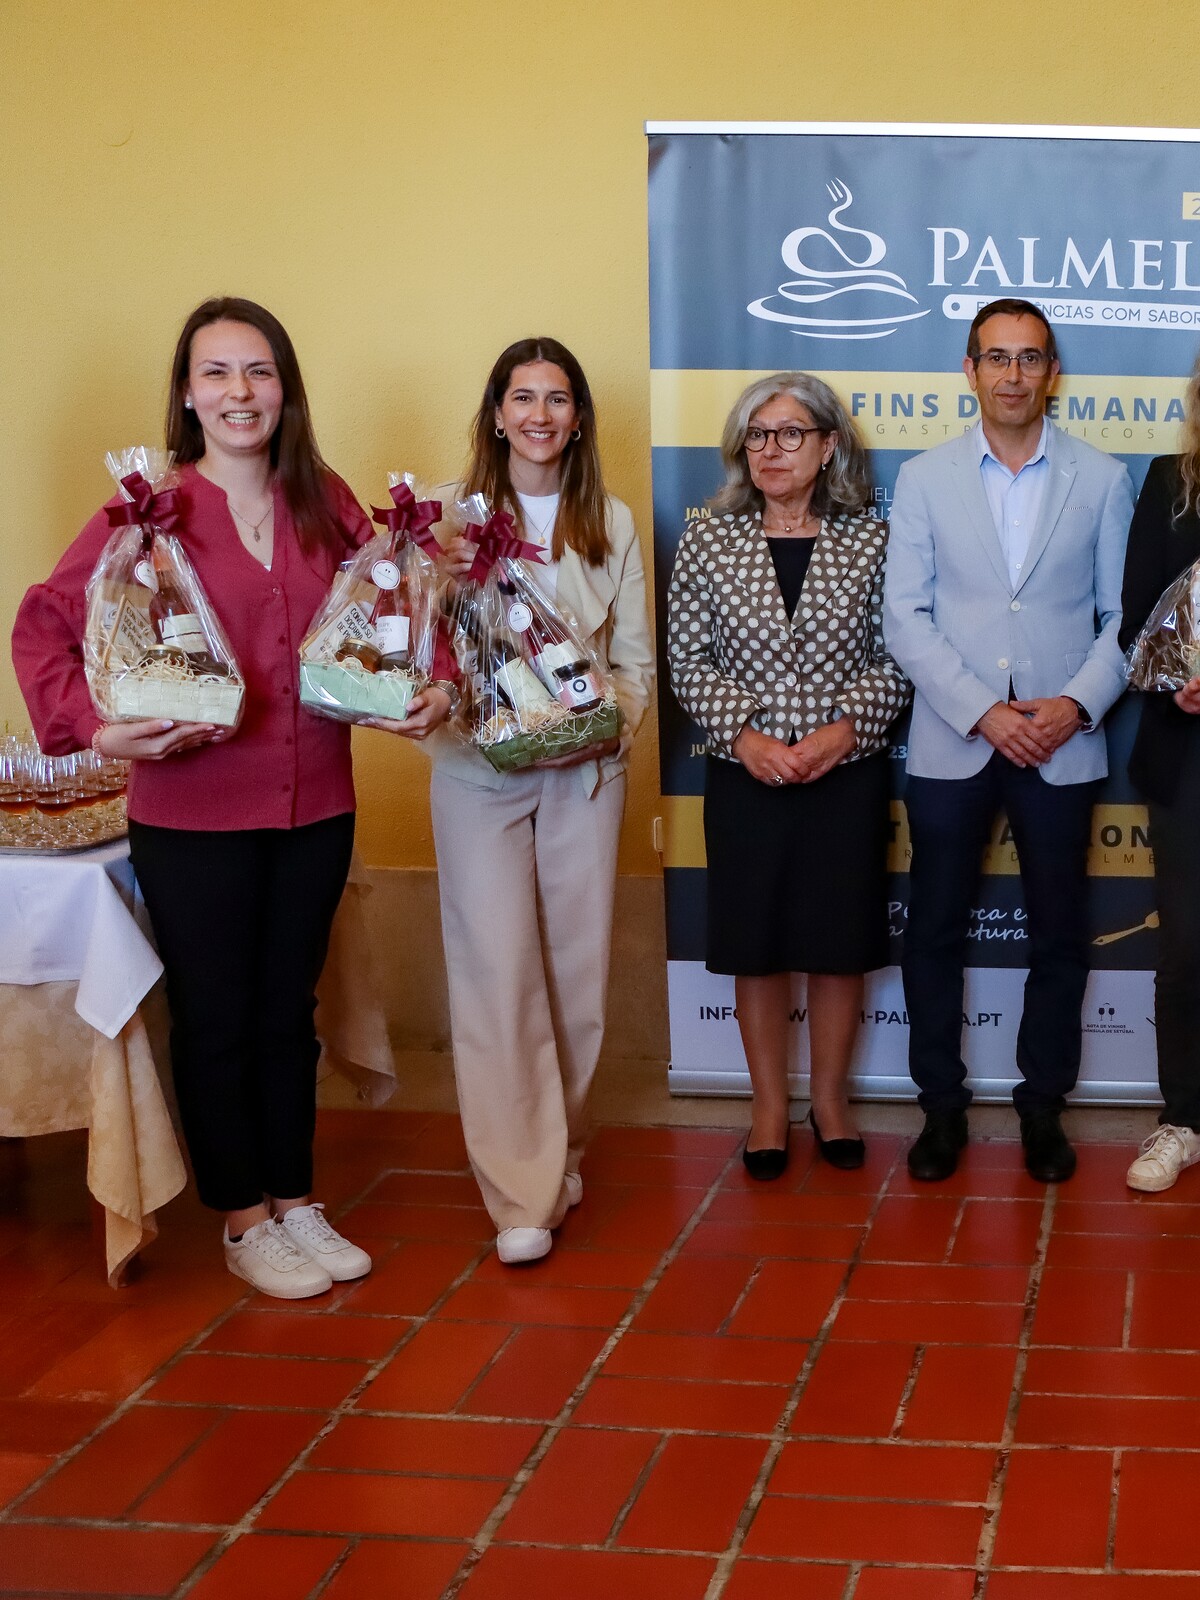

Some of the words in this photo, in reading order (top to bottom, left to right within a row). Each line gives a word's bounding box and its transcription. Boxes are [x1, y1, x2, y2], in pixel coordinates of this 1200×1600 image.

[976, 300, 1094, 320] ENCIAS
[1101, 307, 1141, 322] COM
[851, 392, 940, 418] FINS
[958, 394, 978, 418] D
[1045, 395, 1186, 423] EMANA
[876, 423, 1155, 440] GASTRMICOS
[684, 507, 712, 521] JAN
